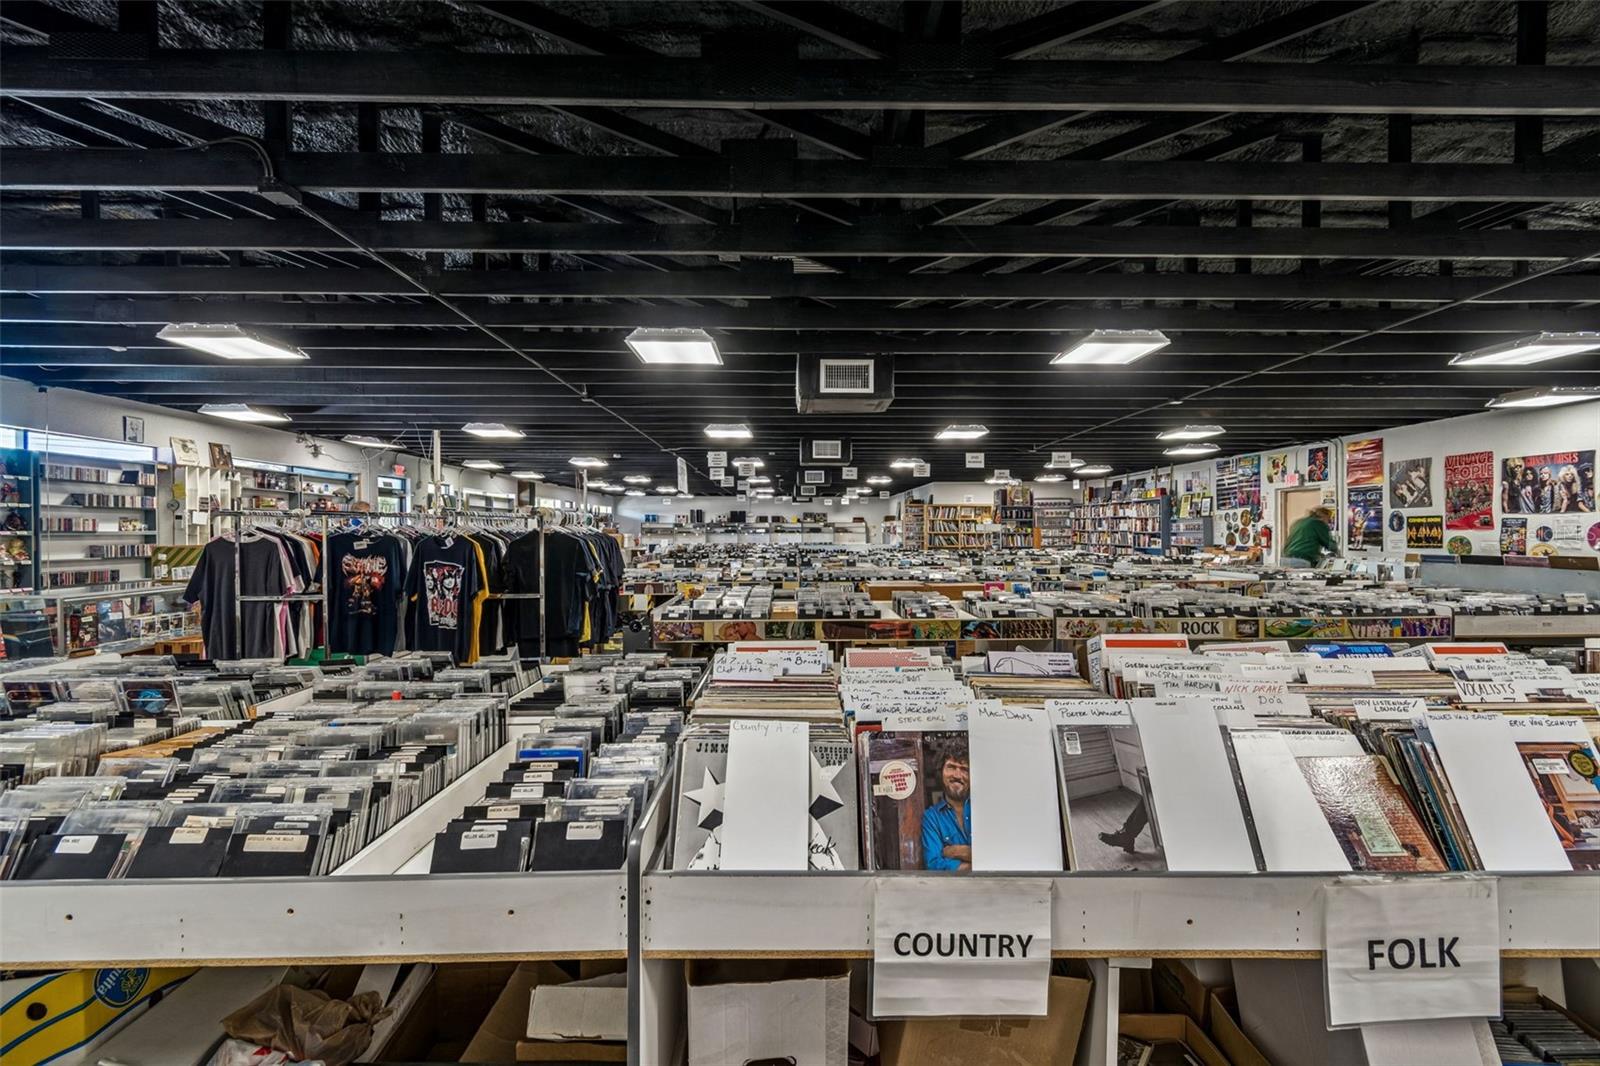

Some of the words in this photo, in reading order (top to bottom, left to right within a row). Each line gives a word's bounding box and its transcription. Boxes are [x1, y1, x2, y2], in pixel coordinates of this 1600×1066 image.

[1446, 452, 1494, 467] VILLAGE
[1446, 463, 1494, 480] PEOPLE
[1181, 621, 1220, 635] ROCK
[1163, 681, 1180, 689] TIM
[1184, 681, 1214, 690] HARDIN
[1224, 685, 1249, 693] NICK
[1253, 685, 1285, 693] DRAKE
[1457, 682, 1516, 697] VOCALISTS
[904, 706, 938, 714] JACKSON
[1059, 707, 1088, 718] PORTER
[1374, 705, 1410, 713] LOUNGE
[897, 715, 922, 723] STEVE
[732, 721, 769, 736] Country
[775, 722, 783, 732] A
[814, 746, 853, 754] LONESOME
[893, 932, 1034, 958] COUNTRY
[1367, 937, 1461, 970] FOLK
